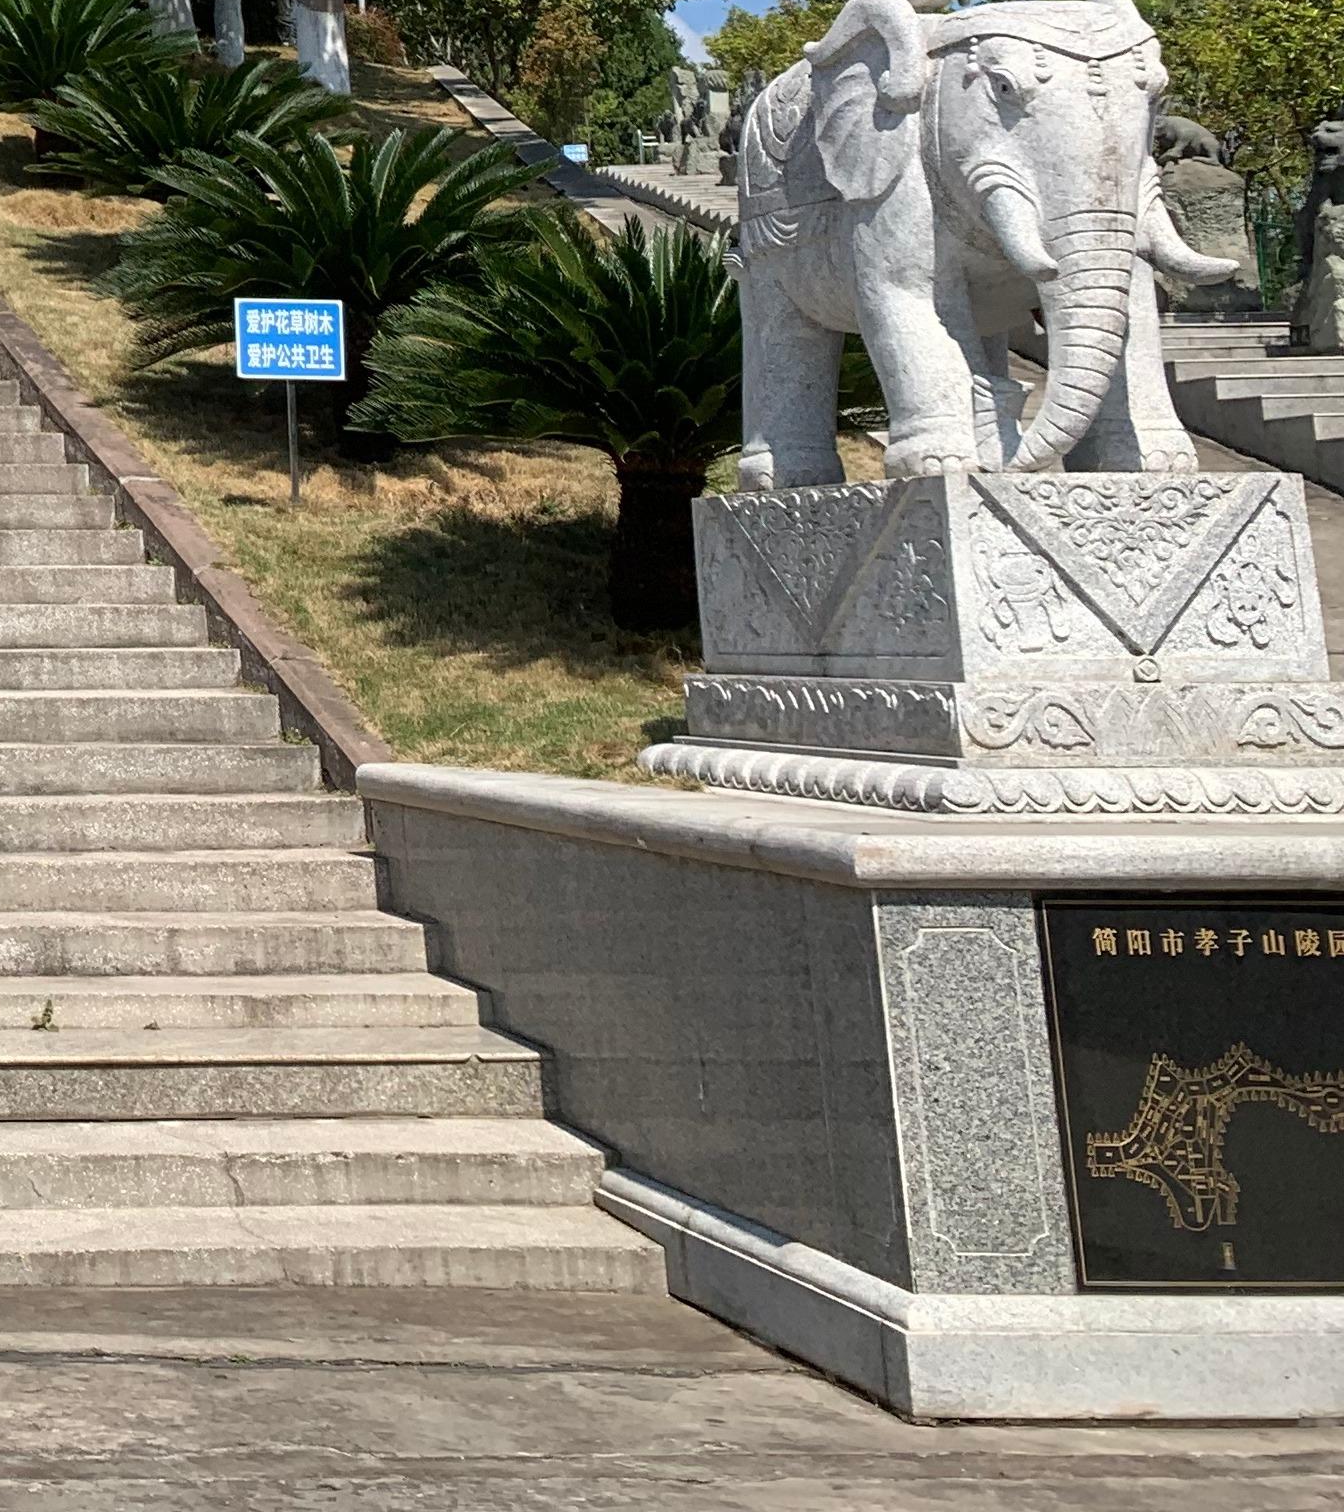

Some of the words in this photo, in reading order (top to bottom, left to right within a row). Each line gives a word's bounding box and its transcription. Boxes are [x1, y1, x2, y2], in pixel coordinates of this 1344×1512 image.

[245, 309, 335, 335] 爱护花草树木
[247, 343, 336, 370] 爱护公共卫生
